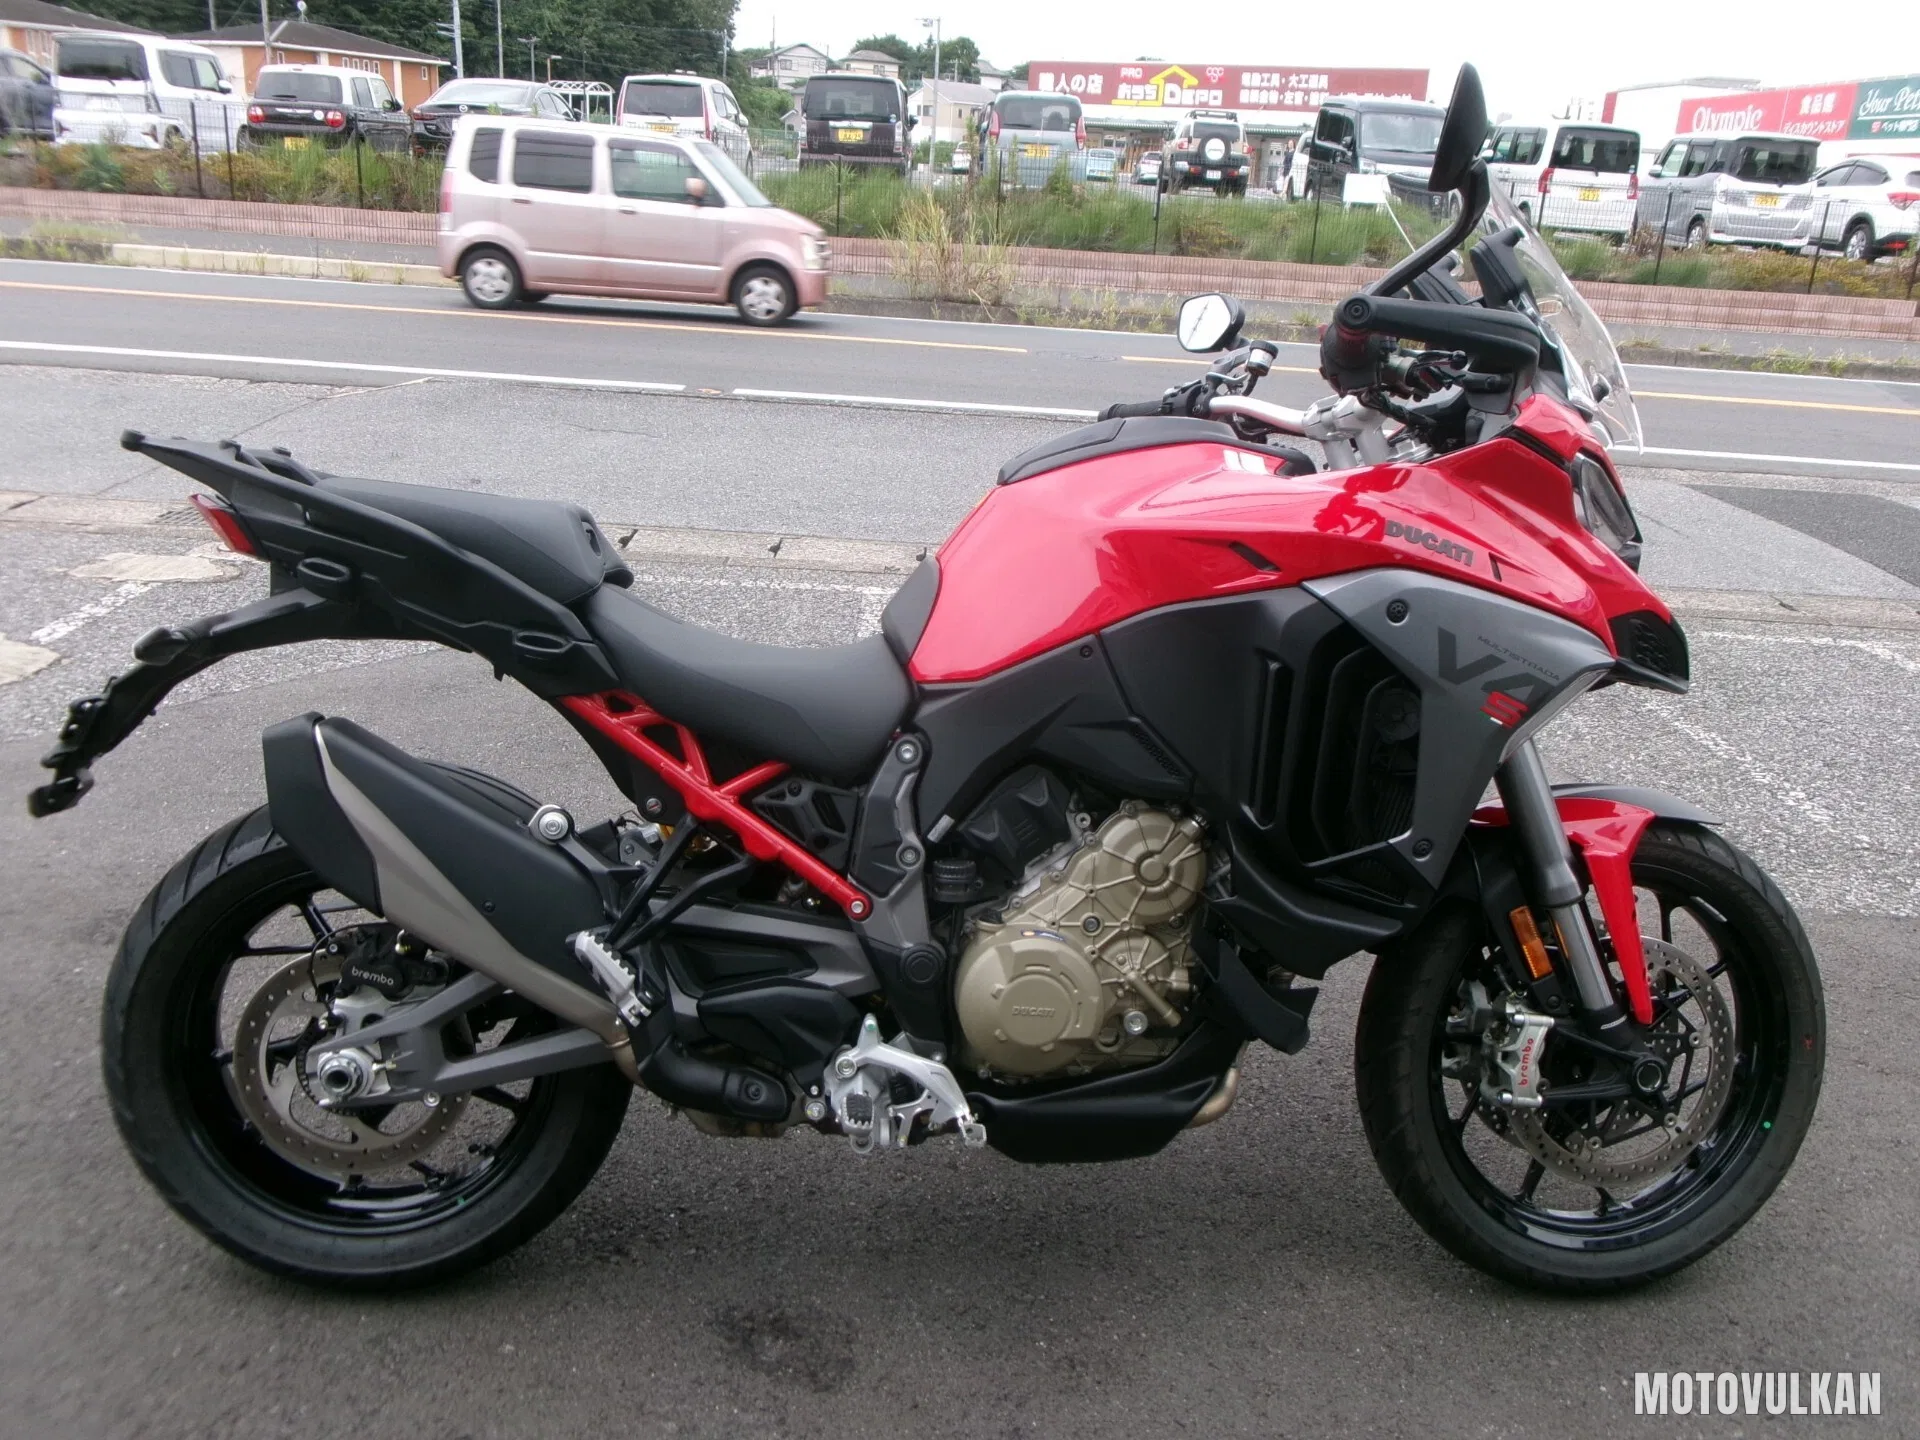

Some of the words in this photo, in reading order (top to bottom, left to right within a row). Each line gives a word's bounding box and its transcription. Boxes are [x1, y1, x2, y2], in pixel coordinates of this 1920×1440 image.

[1121, 67, 1143, 79] PRO
[1859, 89, 1893, 116] Your
[1692, 104, 1763, 133] Olympic
[1384, 519, 1474, 567] DUCATI
[1480, 691, 1529, 729] S
[351, 966, 394, 986] brembo
[1012, 1005, 1056, 1018] DUCATI
[1518, 1037, 1534, 1086] brembo
